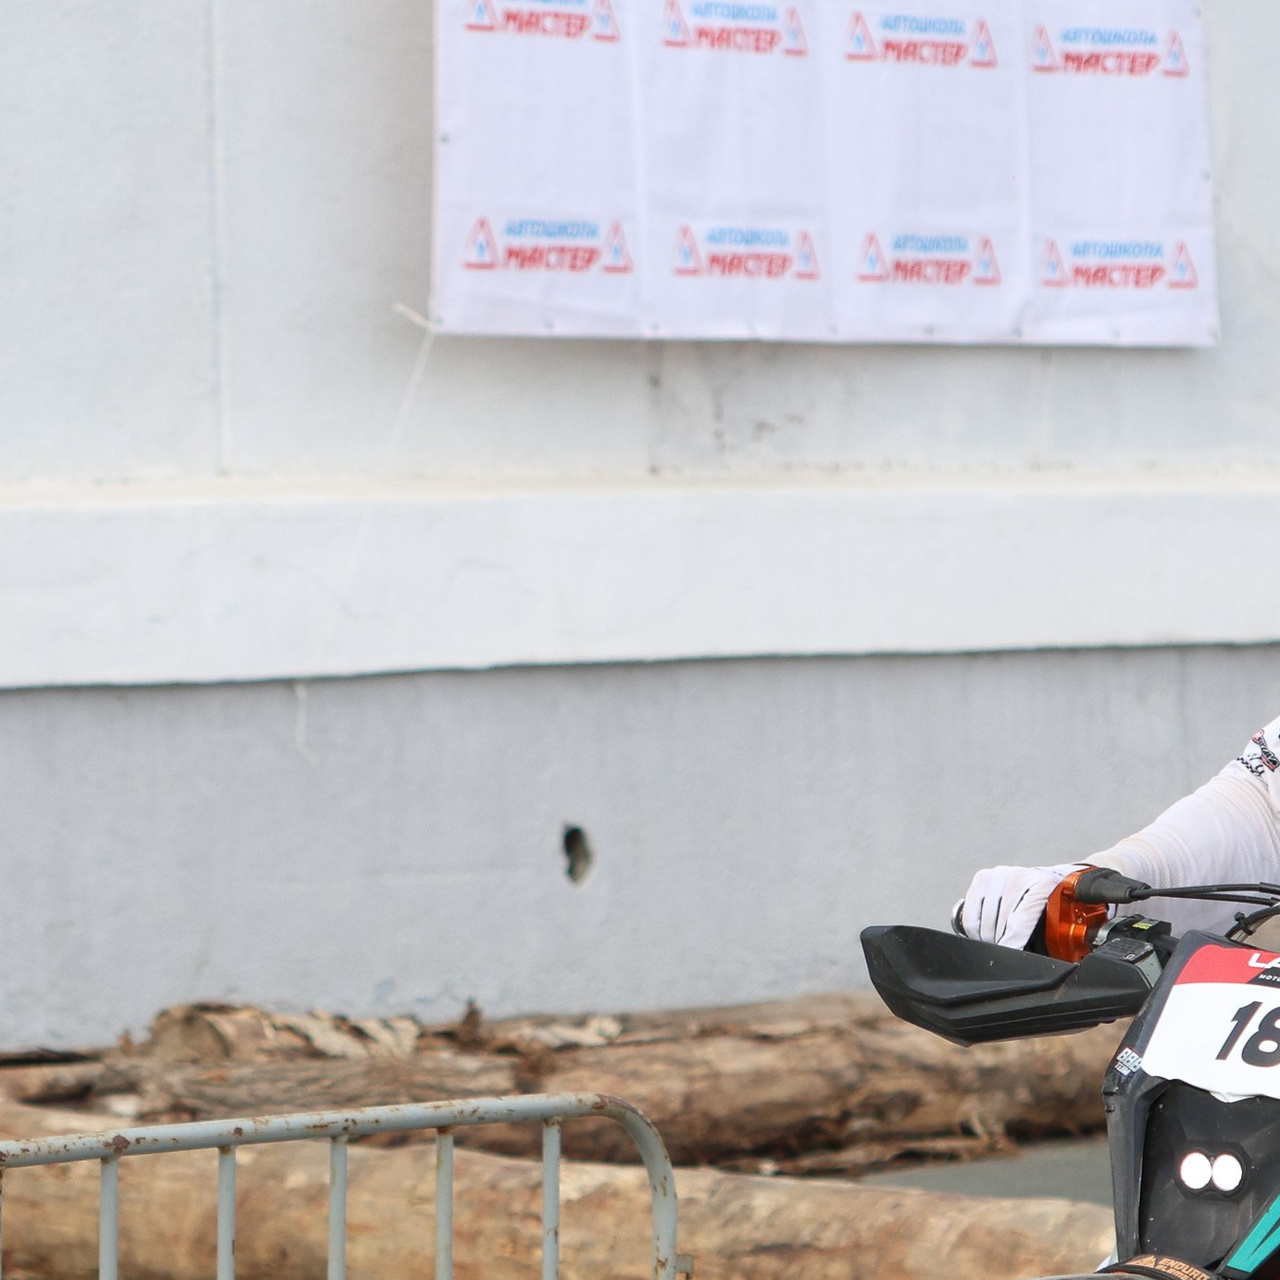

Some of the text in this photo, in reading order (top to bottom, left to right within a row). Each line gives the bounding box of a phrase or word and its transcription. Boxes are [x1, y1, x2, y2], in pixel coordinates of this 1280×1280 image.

[503, 9, 591, 39] МАСТЕР
[695, 27, 782, 54] МАСТЕР
[882, 39, 968, 65] МАСТЕР
[1062, 51, 1160, 77] МАСТЕР
[505, 246, 601, 272] МАСТЕР
[707, 252, 793, 278] МАСТЕР
[893, 258, 971, 285] МАСТЕР
[1072, 263, 1166, 289] МАСТЕР
